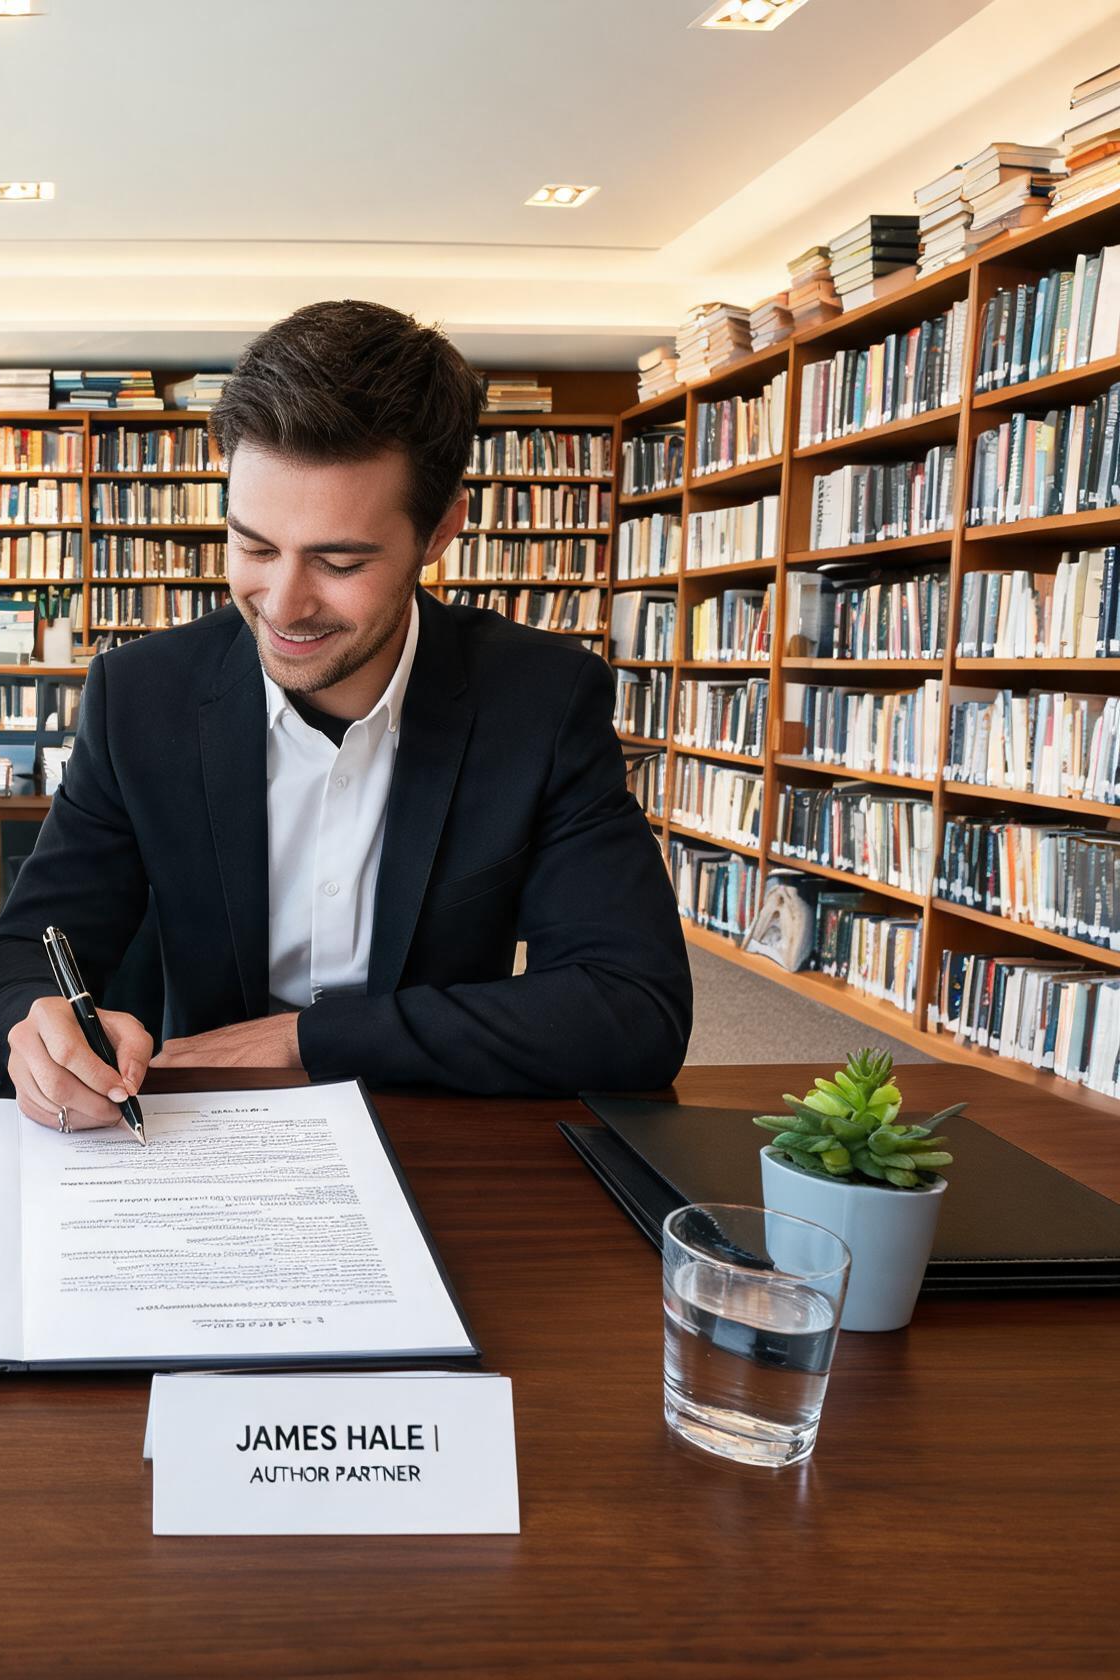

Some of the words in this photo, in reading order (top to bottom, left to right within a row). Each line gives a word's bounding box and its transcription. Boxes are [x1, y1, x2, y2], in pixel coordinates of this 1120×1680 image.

[235, 1424, 338, 1452] JAMES
[347, 1424, 425, 1451] HALE
[249, 1465, 330, 1484] AUTHOR
[335, 1464, 421, 1482] PARTNER
